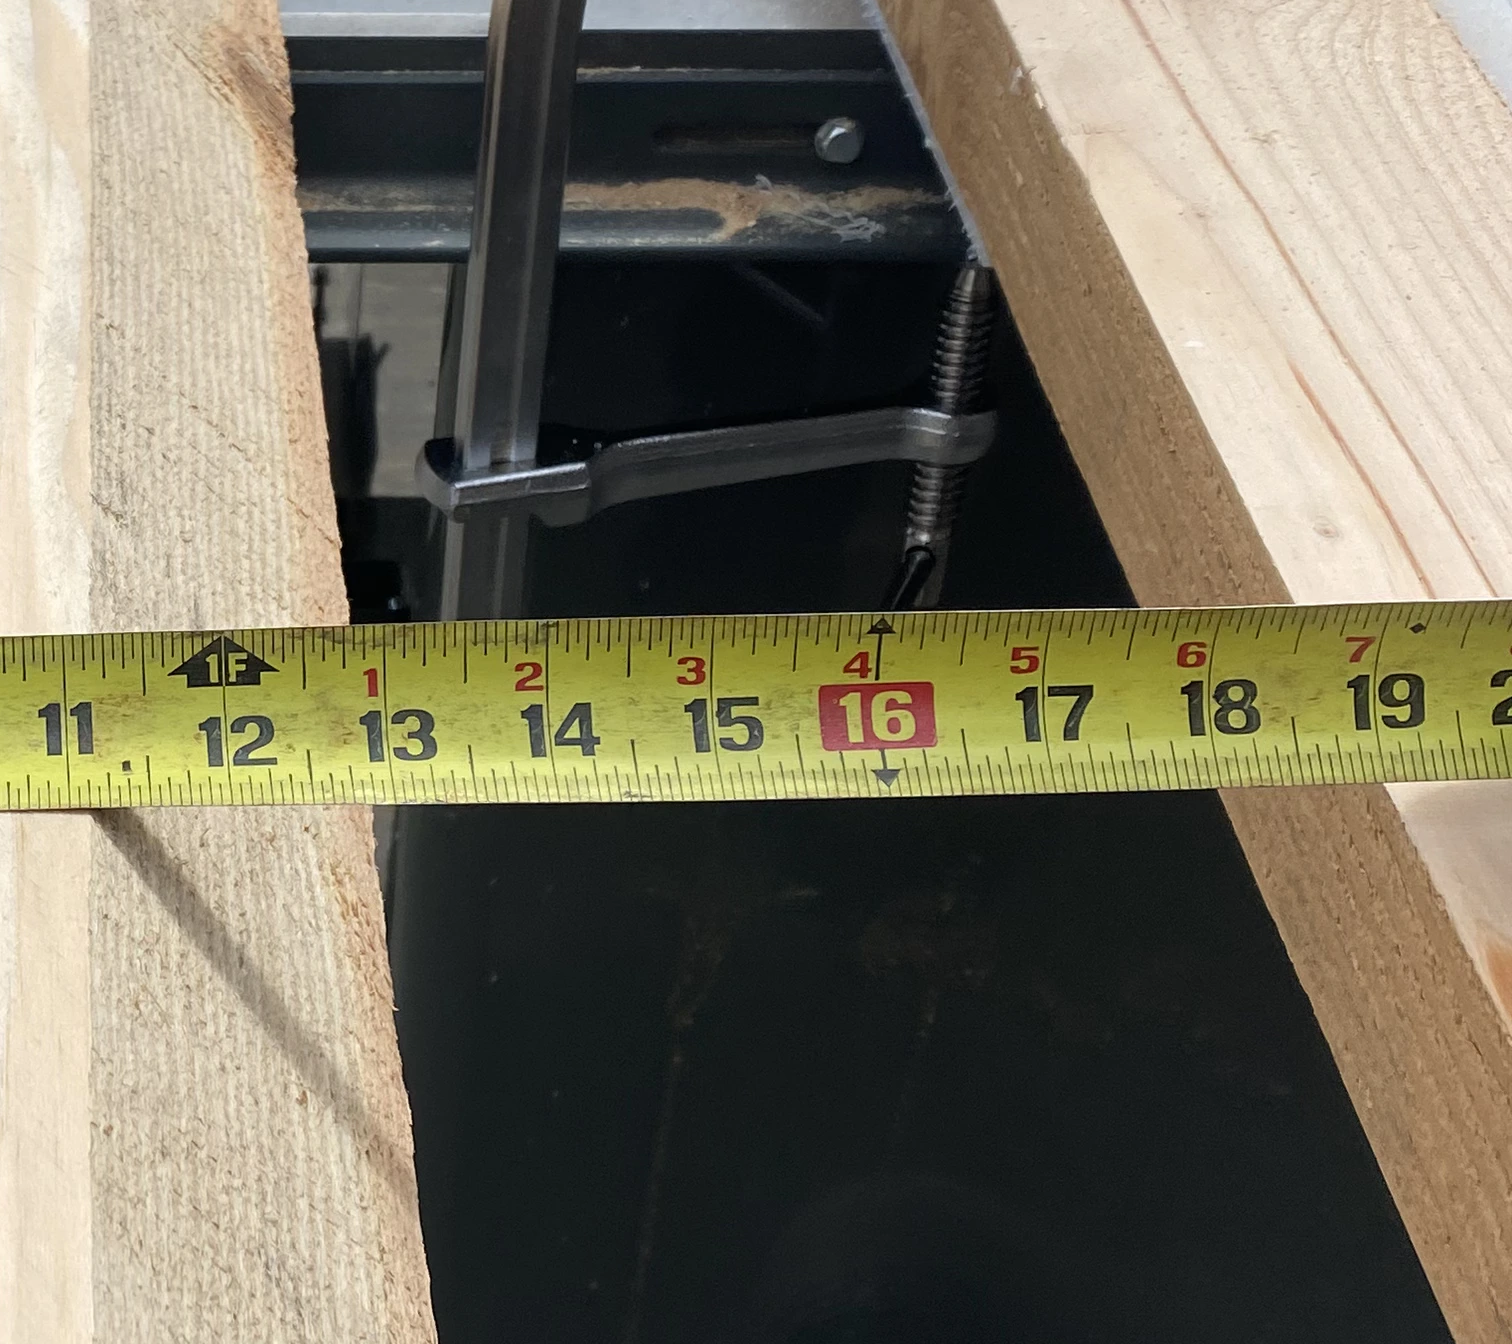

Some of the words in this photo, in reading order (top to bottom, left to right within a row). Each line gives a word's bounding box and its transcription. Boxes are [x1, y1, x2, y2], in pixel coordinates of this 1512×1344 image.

[205, 651, 248, 684] 1F
[363, 668, 378, 697] 1
[514, 662, 544, 691] 2
[676, 657, 706, 685] 3
[842, 651, 872, 679] 4
[1009, 646, 1040, 674] 5
[1176, 641, 1207, 668] 6
[1345, 636, 1377, 663] 7
[38, 702, 94, 756] 11
[198, 715, 278, 767] 12
[359, 709, 438, 762] 13
[520, 702, 601, 757] 14
[684, 697, 764, 752] 15
[839, 690, 916, 744] 16
[1015, 685, 1094, 742] 17
[1181, 679, 1262, 736] 18
[1347, 673, 1426, 731] 19
